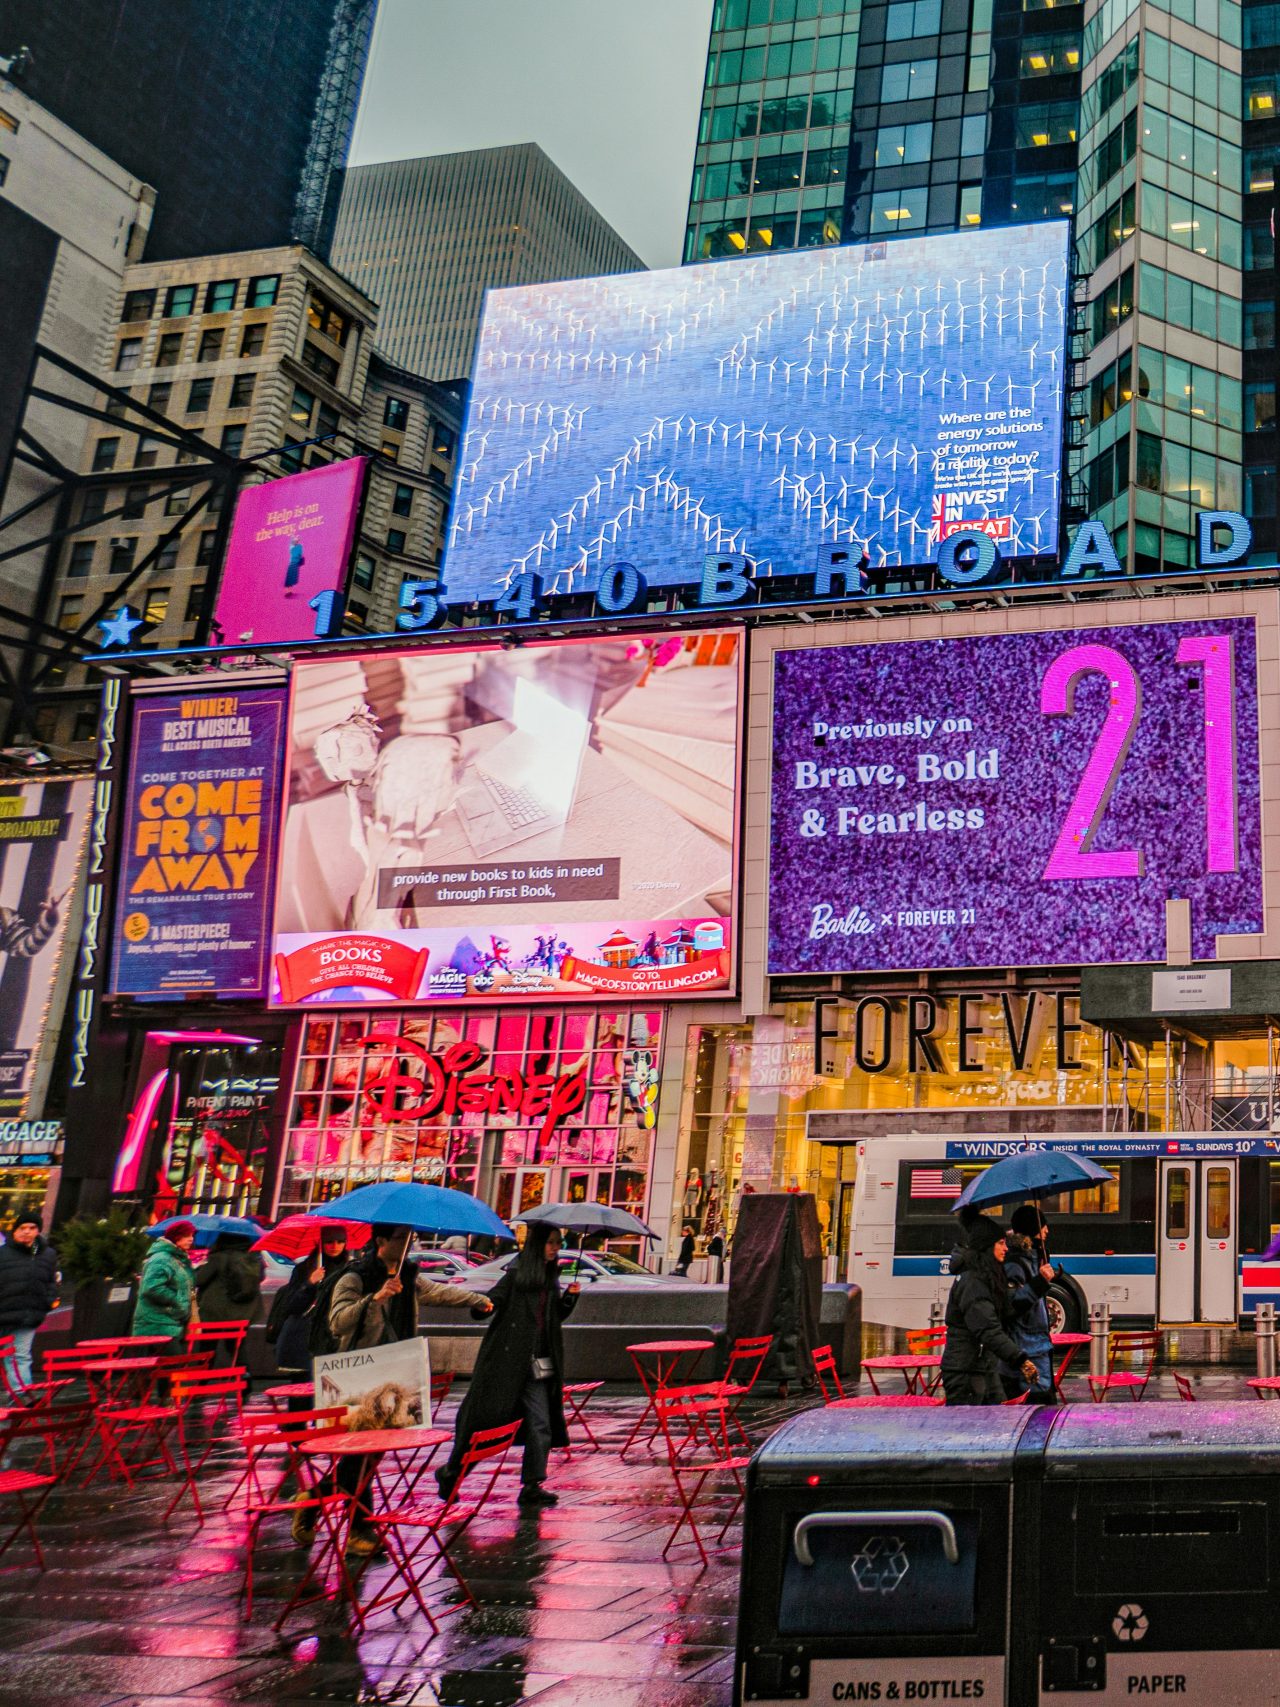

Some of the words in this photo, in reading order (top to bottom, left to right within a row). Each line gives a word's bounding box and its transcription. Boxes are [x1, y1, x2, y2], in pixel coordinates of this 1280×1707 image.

[939, 412, 982, 425] Where
[984, 409, 1006, 421] are
[1009, 407, 1032, 418] the
[938, 427, 983, 441] energy
[985, 421, 1044, 436] solutions
[937, 443, 952, 456] of
[953, 440, 1018, 454] tomorrow
[936, 462, 945, 471] a
[949, 456, 990, 470] reality
[993, 451, 1039, 467] today?
[967, 472, 978, 480] UK
[1011, 469, 1029, 477] ready
[969, 480, 981, 488] you
[945, 488, 1008, 507] INVEST
[266, 508, 294, 526] Help
[294, 505, 304, 518] is
[304, 503, 320, 515] on
[945, 507, 963, 521] IN
[255, 528, 273, 542] the
[275, 522, 296, 537] way,
[298, 514, 325, 530] dear.
[309, 562, 646, 638] 1540
[180, 697, 238, 719] WINNER!
[162, 720, 195, 741] BEST
[196, 716, 252, 739] MUSICAL
[813, 714, 938, 740] Previously
[942, 717, 974, 734] on
[162, 742, 175, 752] ALL
[175, 740, 200, 751] ACROSS
[202, 738, 222, 750] NORTH
[223, 736, 252, 748] AMERICA
[1041, 635, 1240, 881] 21
[142, 772, 177, 783] COME
[181, 768, 245, 781] TOGETHER
[249, 766, 265, 777] AT
[794, 761, 907, 790] Brave,
[917, 748, 1000, 783] Bold
[139, 779, 263, 819] COME
[800, 808, 827, 838] &
[837, 801, 985, 836] Fearless
[130, 852, 259, 894] AWAY
[392, 871, 439, 887] provide
[442, 871, 468, 883] new
[470, 867, 508, 882] books
[511, 867, 526, 880] to
[529, 866, 553, 879] kids
[557, 866, 569, 878] in
[572, 863, 604, 877] need
[437, 887, 486, 903] through
[488, 885, 518, 898] First
[520, 883, 556, 899] Book,
[655, 880, 680, 890] Disney
[146, 894, 201, 904] REMARKABLE
[203, 893, 225, 902] TRUE
[226, 892, 256, 900] STORY
[809, 903, 876, 940] Barbie
[897, 909, 956, 927] FOREVER
[961, 908, 976, 925] 21
[161, 922, 231, 940] MASTERPIECE!
[311, 942, 337, 953] SHARE
[354, 940, 379, 948] MAGIC
[320, 947, 382, 965] BOOKS
[310, 976, 324, 984] THE
[325, 970, 353, 980] CHANCE
[365, 972, 394, 984] BELIEVE
[319, 966, 337, 975] GIVE
[351, 964, 386, 974] CHILDREN
[430, 973, 467, 984] MAGIC
[632, 972, 646, 980] GO
[646, 971, 660, 980] TO:
[473, 975, 495, 985] abc
[576, 968, 717, 991] MAGICOFSTORYTELLING.COM
[358, 1034, 586, 1147] Disney
[231, 1095, 266, 1107] PAINT
[1098, 1144, 1122, 1152] ROYAL
[1196, 1143, 1234, 1151] SUNDAYS
[321, 1354, 375, 1372] ARITZIA
[832, 1681, 882, 1701] CANS
[886, 1681, 901, 1700] &
[904, 1679, 985, 1700] BOTTLES
[1127, 1675, 1187, 1694] PAPER
